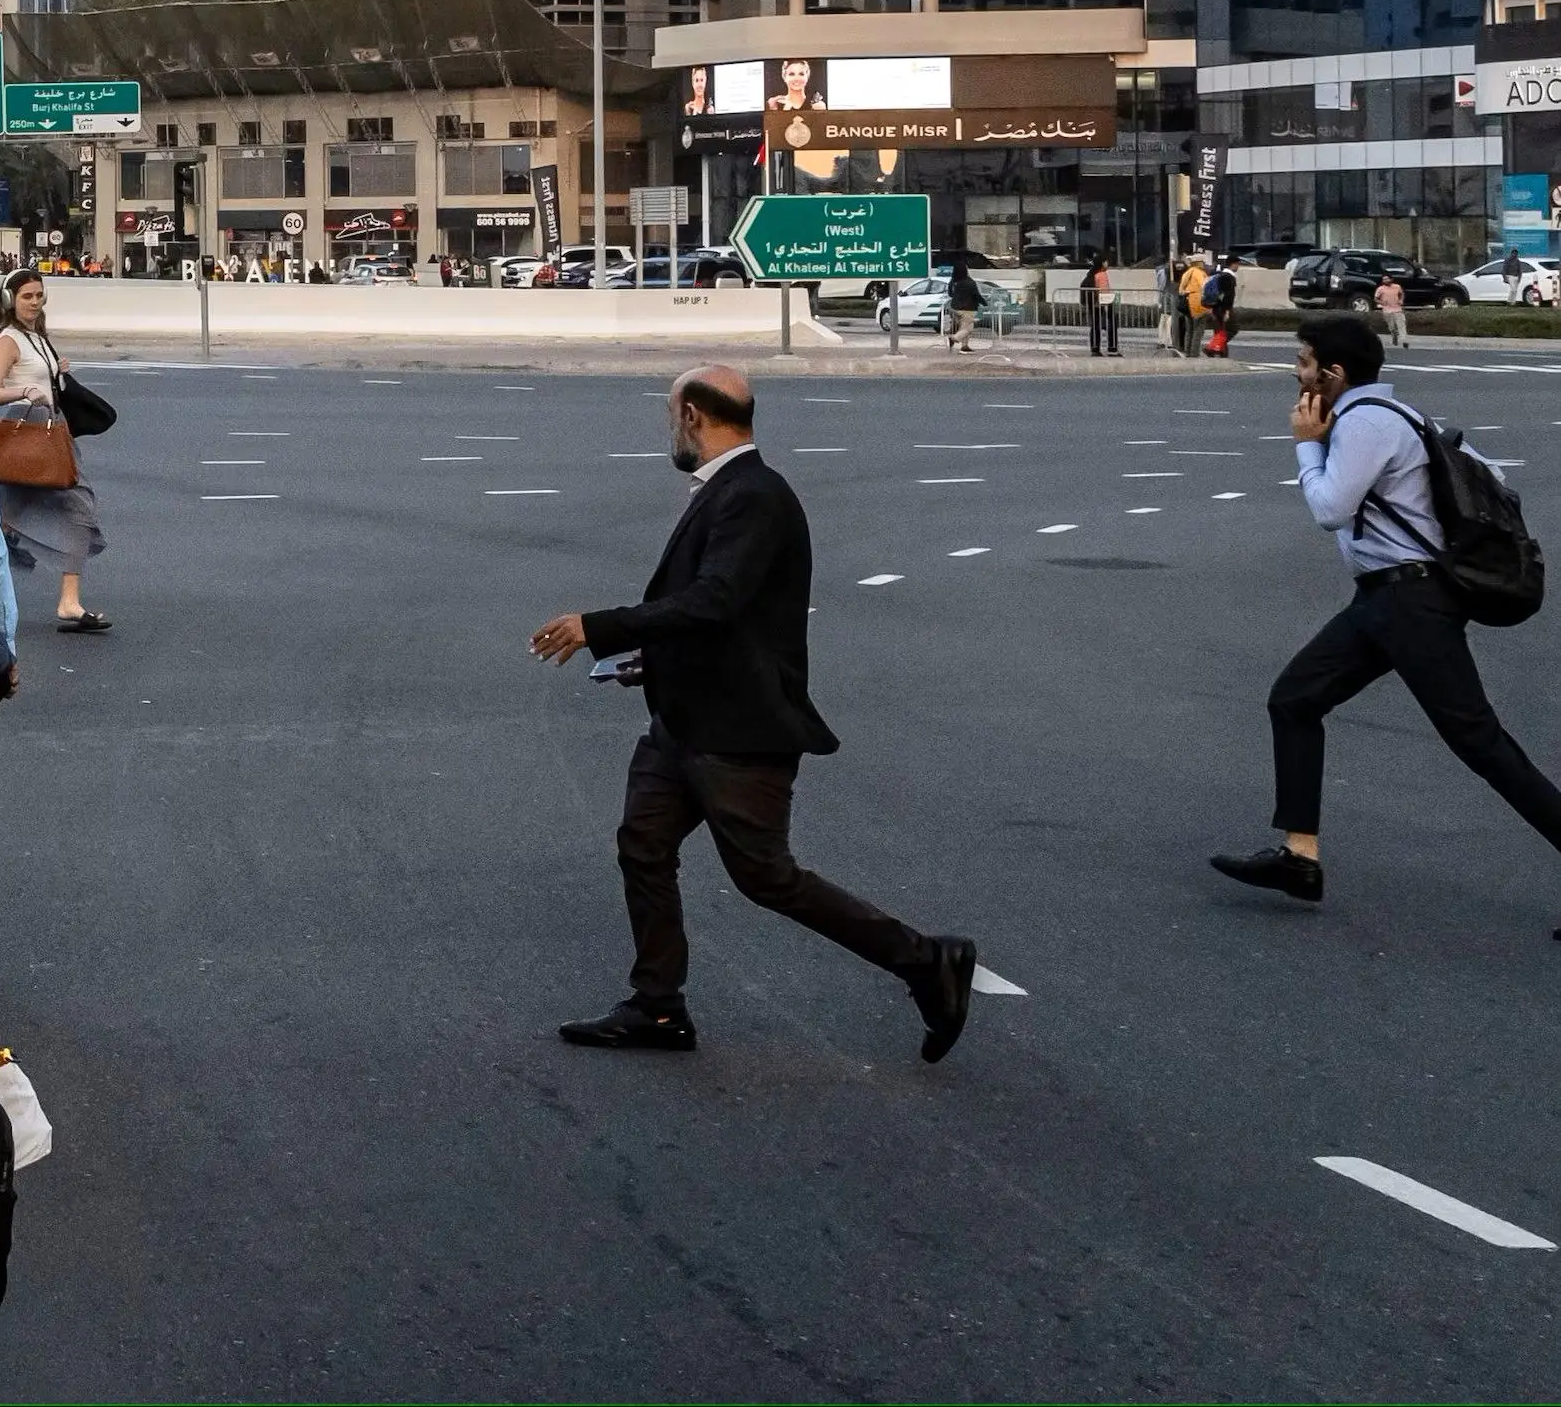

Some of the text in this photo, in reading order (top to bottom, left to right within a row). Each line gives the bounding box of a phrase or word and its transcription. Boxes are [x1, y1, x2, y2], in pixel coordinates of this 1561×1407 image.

[34, 87, 116, 100] شارع برج خليفة
[32, 102, 94, 112] Burj Khalifa St
[9, 120, 35, 128] 250m
[826, 124, 948, 139] BANQUE MISR
[80, 165, 94, 210] KFC
[1193, 146, 1217, 237] Fitness First
[285, 218, 301, 229] 60
[476, 218, 493, 226] 600
[824, 224, 865, 237] (West)
[773, 241, 827, 258] التجاري
[834, 241, 882, 259] الخليج
[889, 241, 927, 259] شارع
[768, 261, 910, 275] Al Khaleej Al Tejari 1 St
